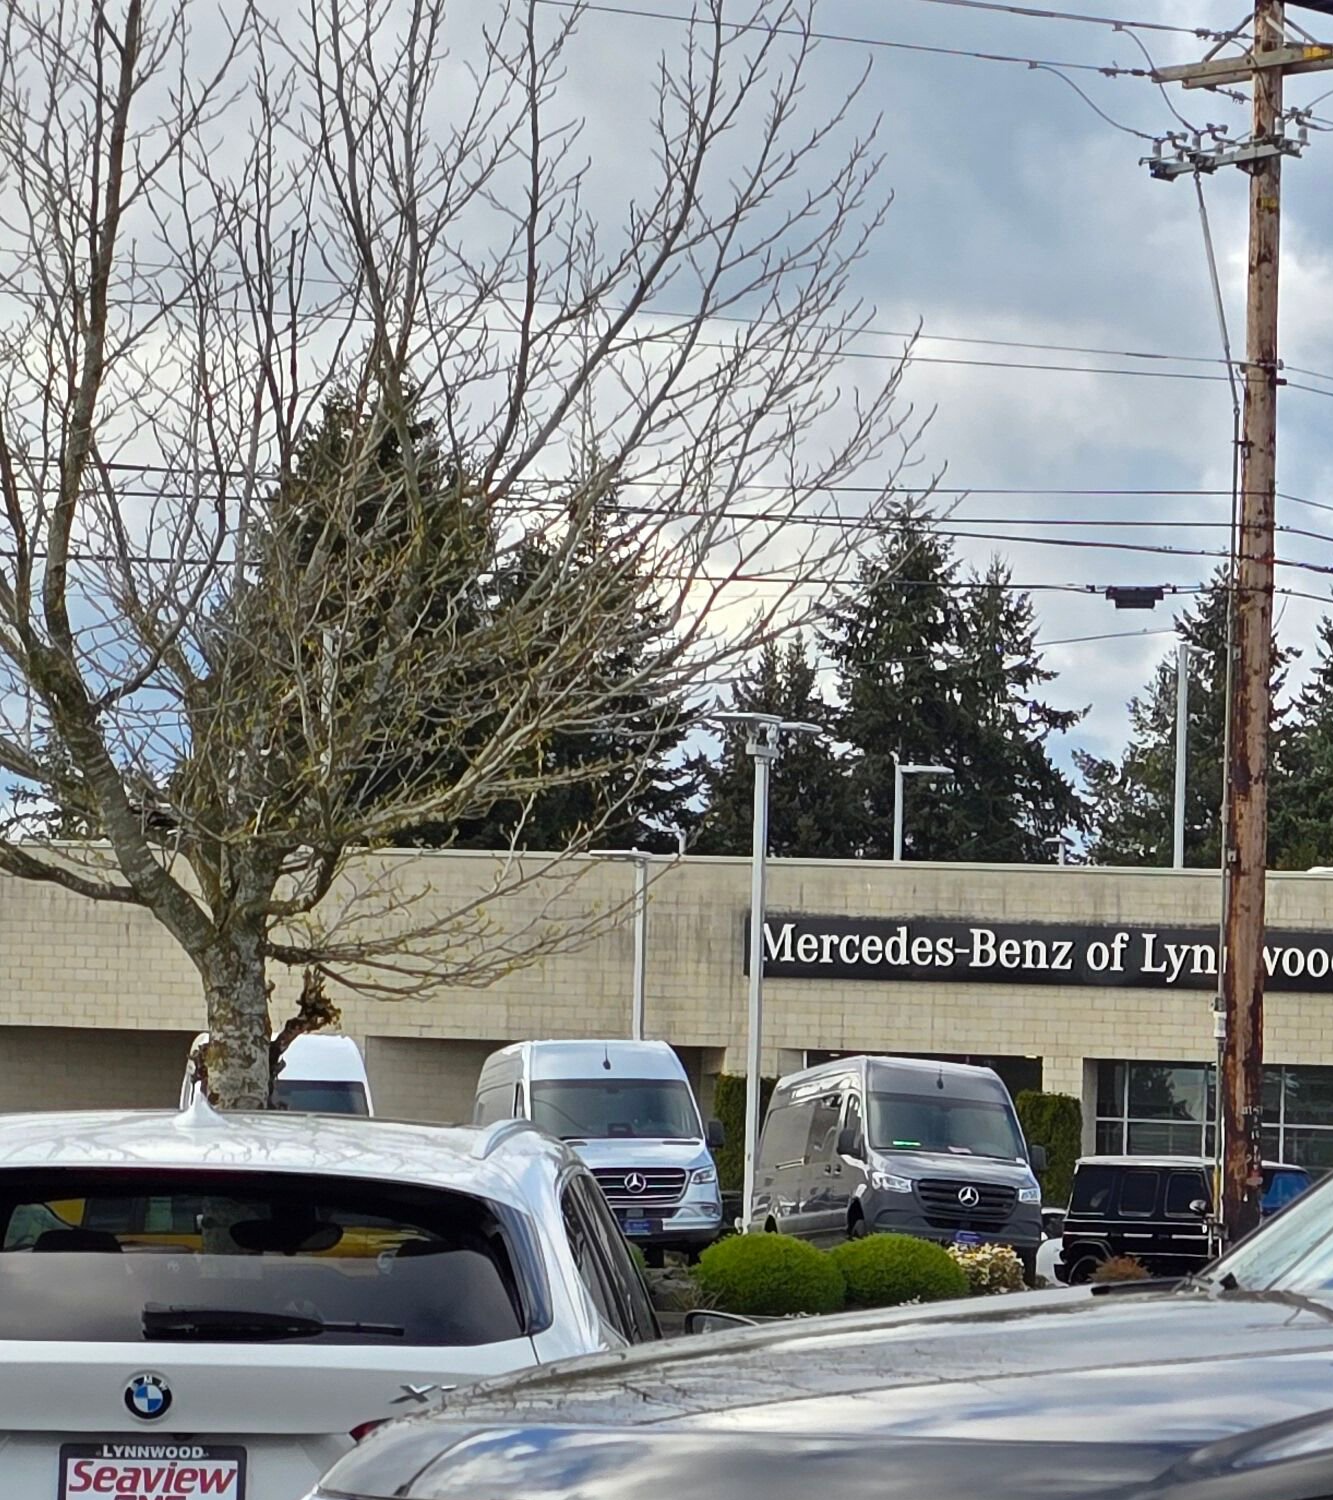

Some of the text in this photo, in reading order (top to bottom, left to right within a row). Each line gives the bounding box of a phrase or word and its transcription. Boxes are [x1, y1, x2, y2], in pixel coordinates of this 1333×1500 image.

[763, 923, 1072, 971] Mercedes-Benz
[1086, 932, 1130, 972] of
[102, 1445, 204, 1459] LYNNWOOD
[68, 1460, 237, 1494] Seaview
